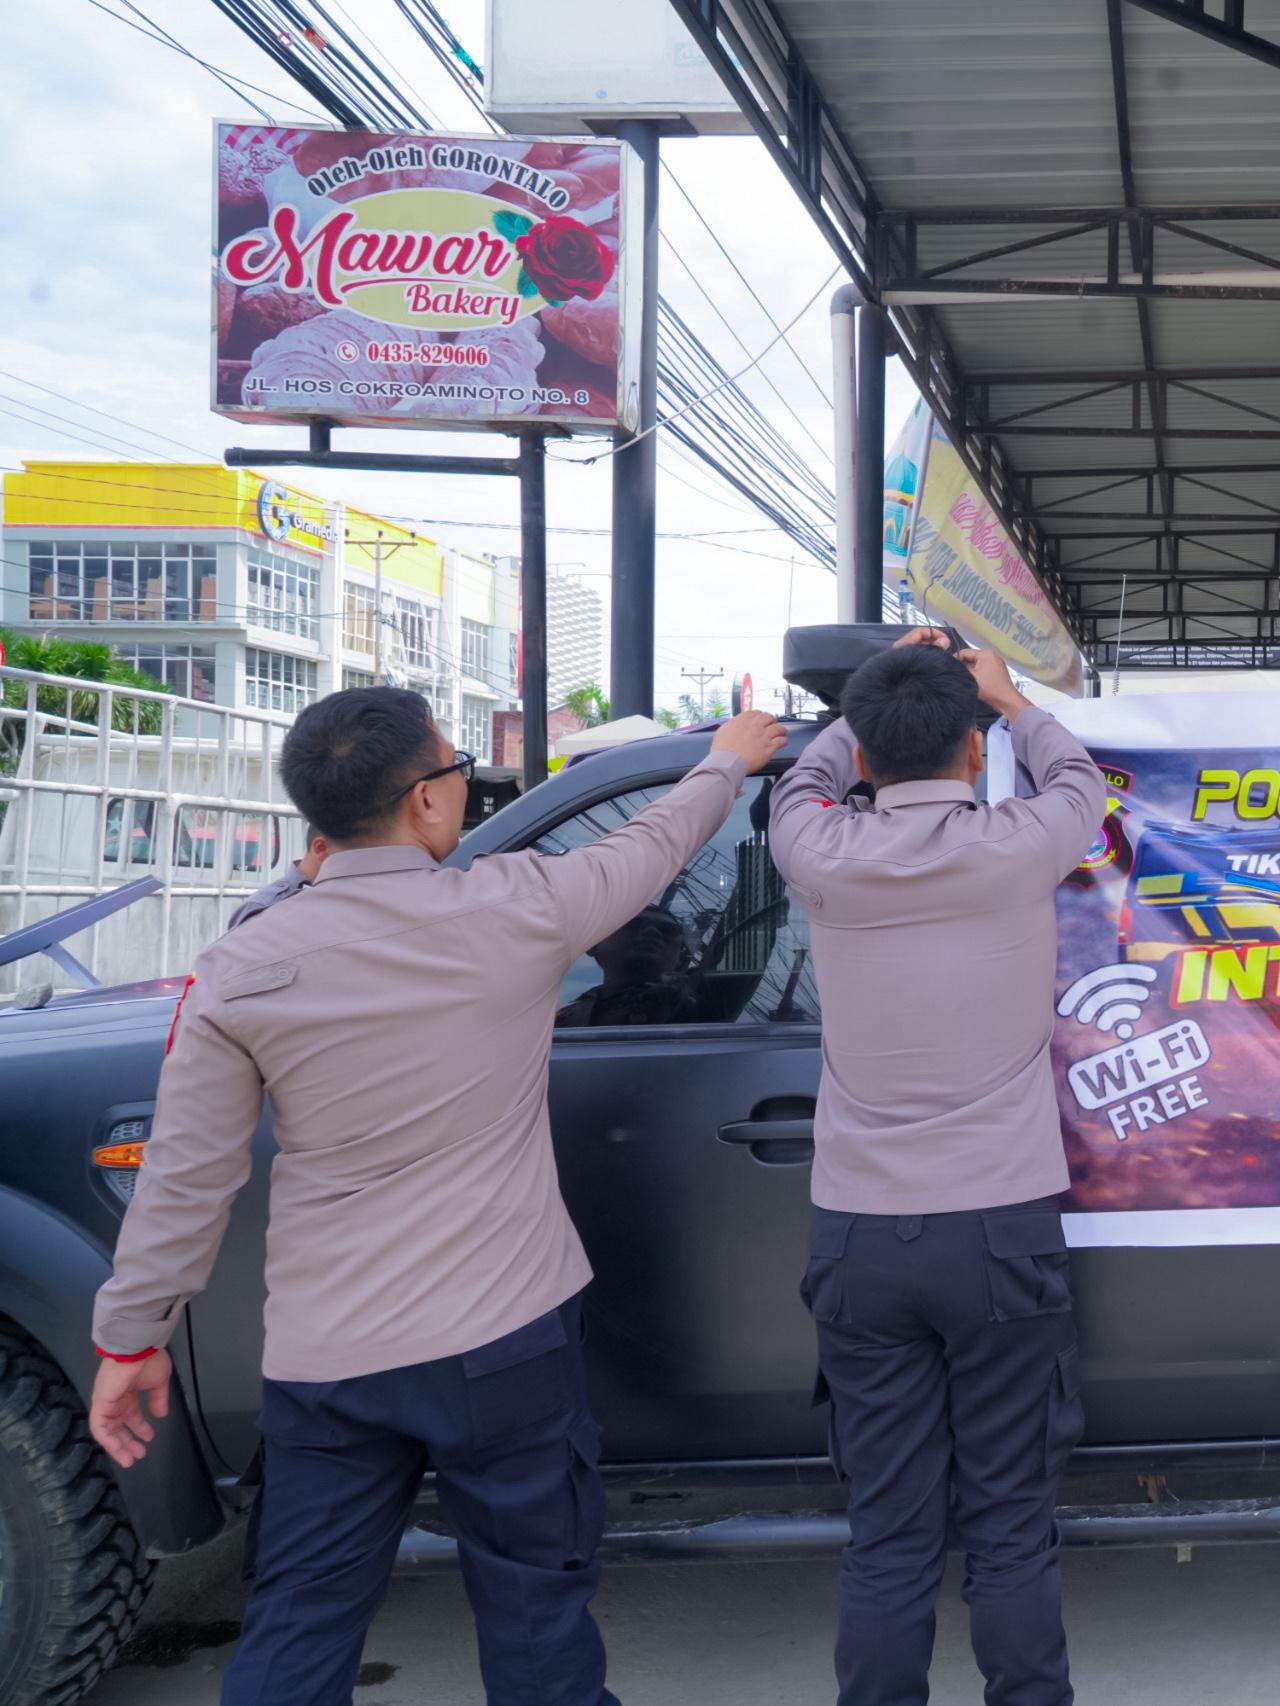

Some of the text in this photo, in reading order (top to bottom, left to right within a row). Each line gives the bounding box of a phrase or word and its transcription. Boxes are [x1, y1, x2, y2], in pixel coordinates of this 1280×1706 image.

[308, 147, 570, 209] Oleh-Oleh GORONTALO
[226, 208, 512, 306] Mawar
[406, 284, 519, 324] Bakery
[368, 343, 488, 366] 0435-829606
[246, 378, 589, 404] JL. HOS COKROAMINOTO NO. 8
[1076, 1024, 1202, 1101] Wi-Fi
[1106, 1075, 1209, 1142] FREE
